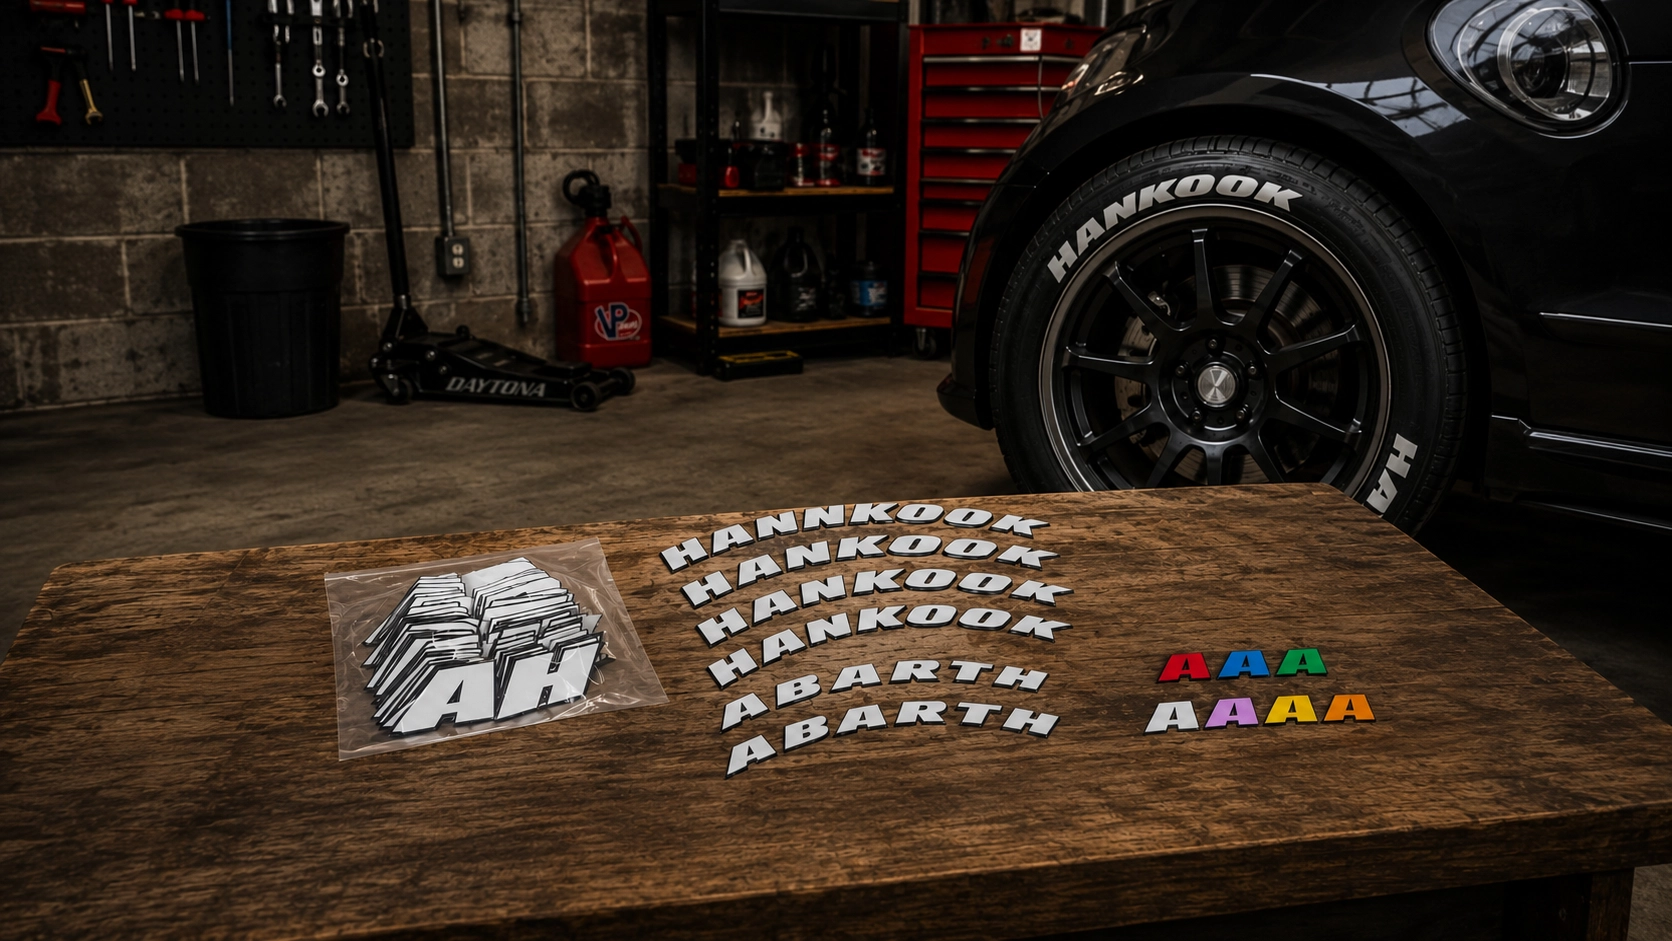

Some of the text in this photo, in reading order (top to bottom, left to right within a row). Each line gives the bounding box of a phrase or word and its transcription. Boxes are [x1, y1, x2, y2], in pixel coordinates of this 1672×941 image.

[1047, 174, 1303, 283] HANKOOK
[594, 302, 630, 341] VP
[445, 376, 547, 398] DAYTONA
[1362, 433, 1418, 518] HA
[659, 502, 1050, 573] HANNKOOK
[680, 534, 1060, 609] HANKOOK
[695, 568, 1074, 648] HANKOOK
[706, 604, 1074, 690] HANKOOK
[720, 659, 1050, 733] ABARTH
[724, 701, 1060, 779] ABARTH
